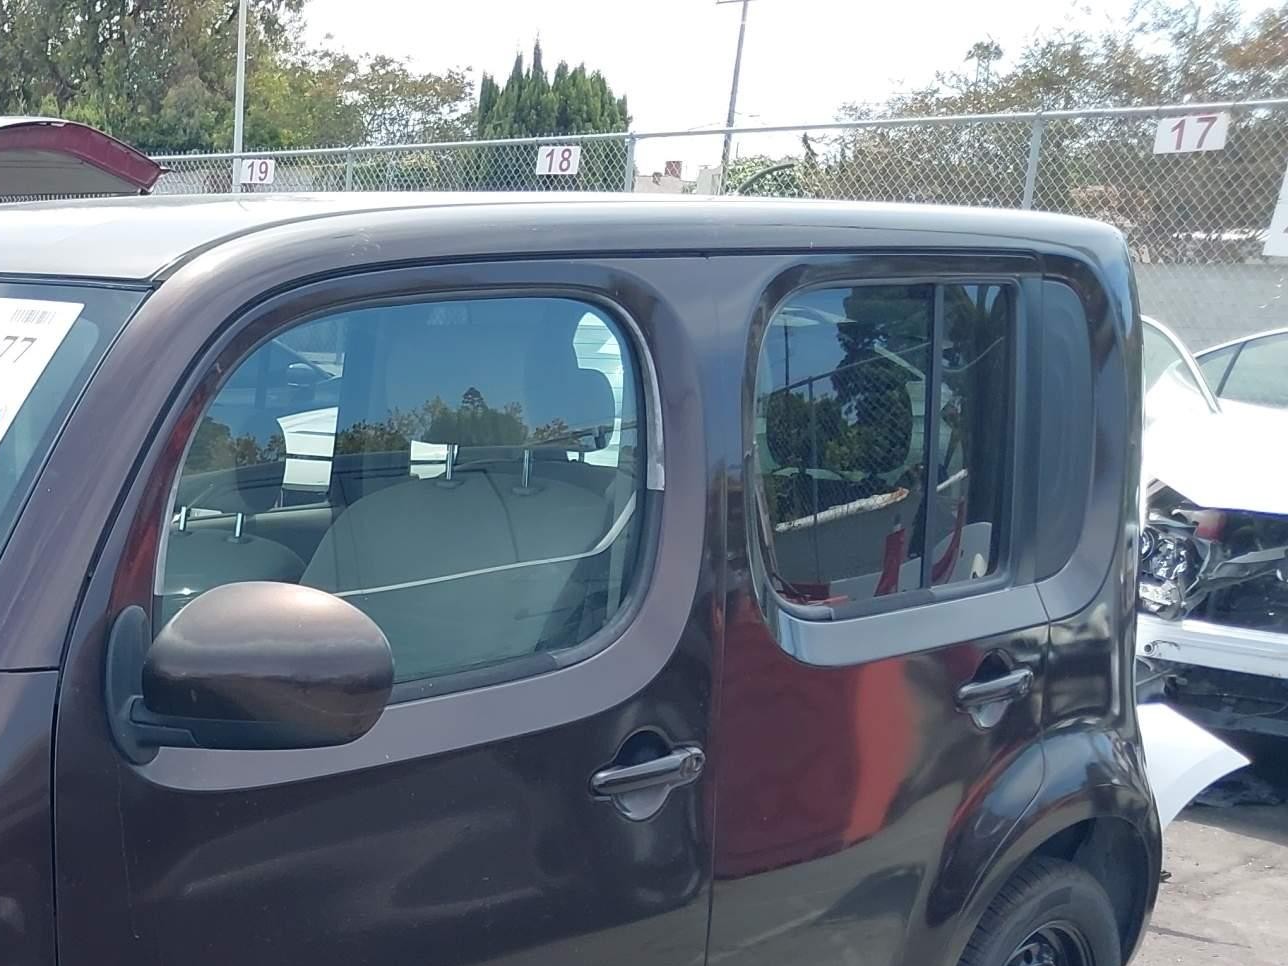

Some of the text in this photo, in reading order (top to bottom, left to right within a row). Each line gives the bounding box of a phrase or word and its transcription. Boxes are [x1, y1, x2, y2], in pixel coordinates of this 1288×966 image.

[1170, 116, 1218, 151] 17
[247, 160, 269, 182] 19
[545, 147, 572, 173] 18
